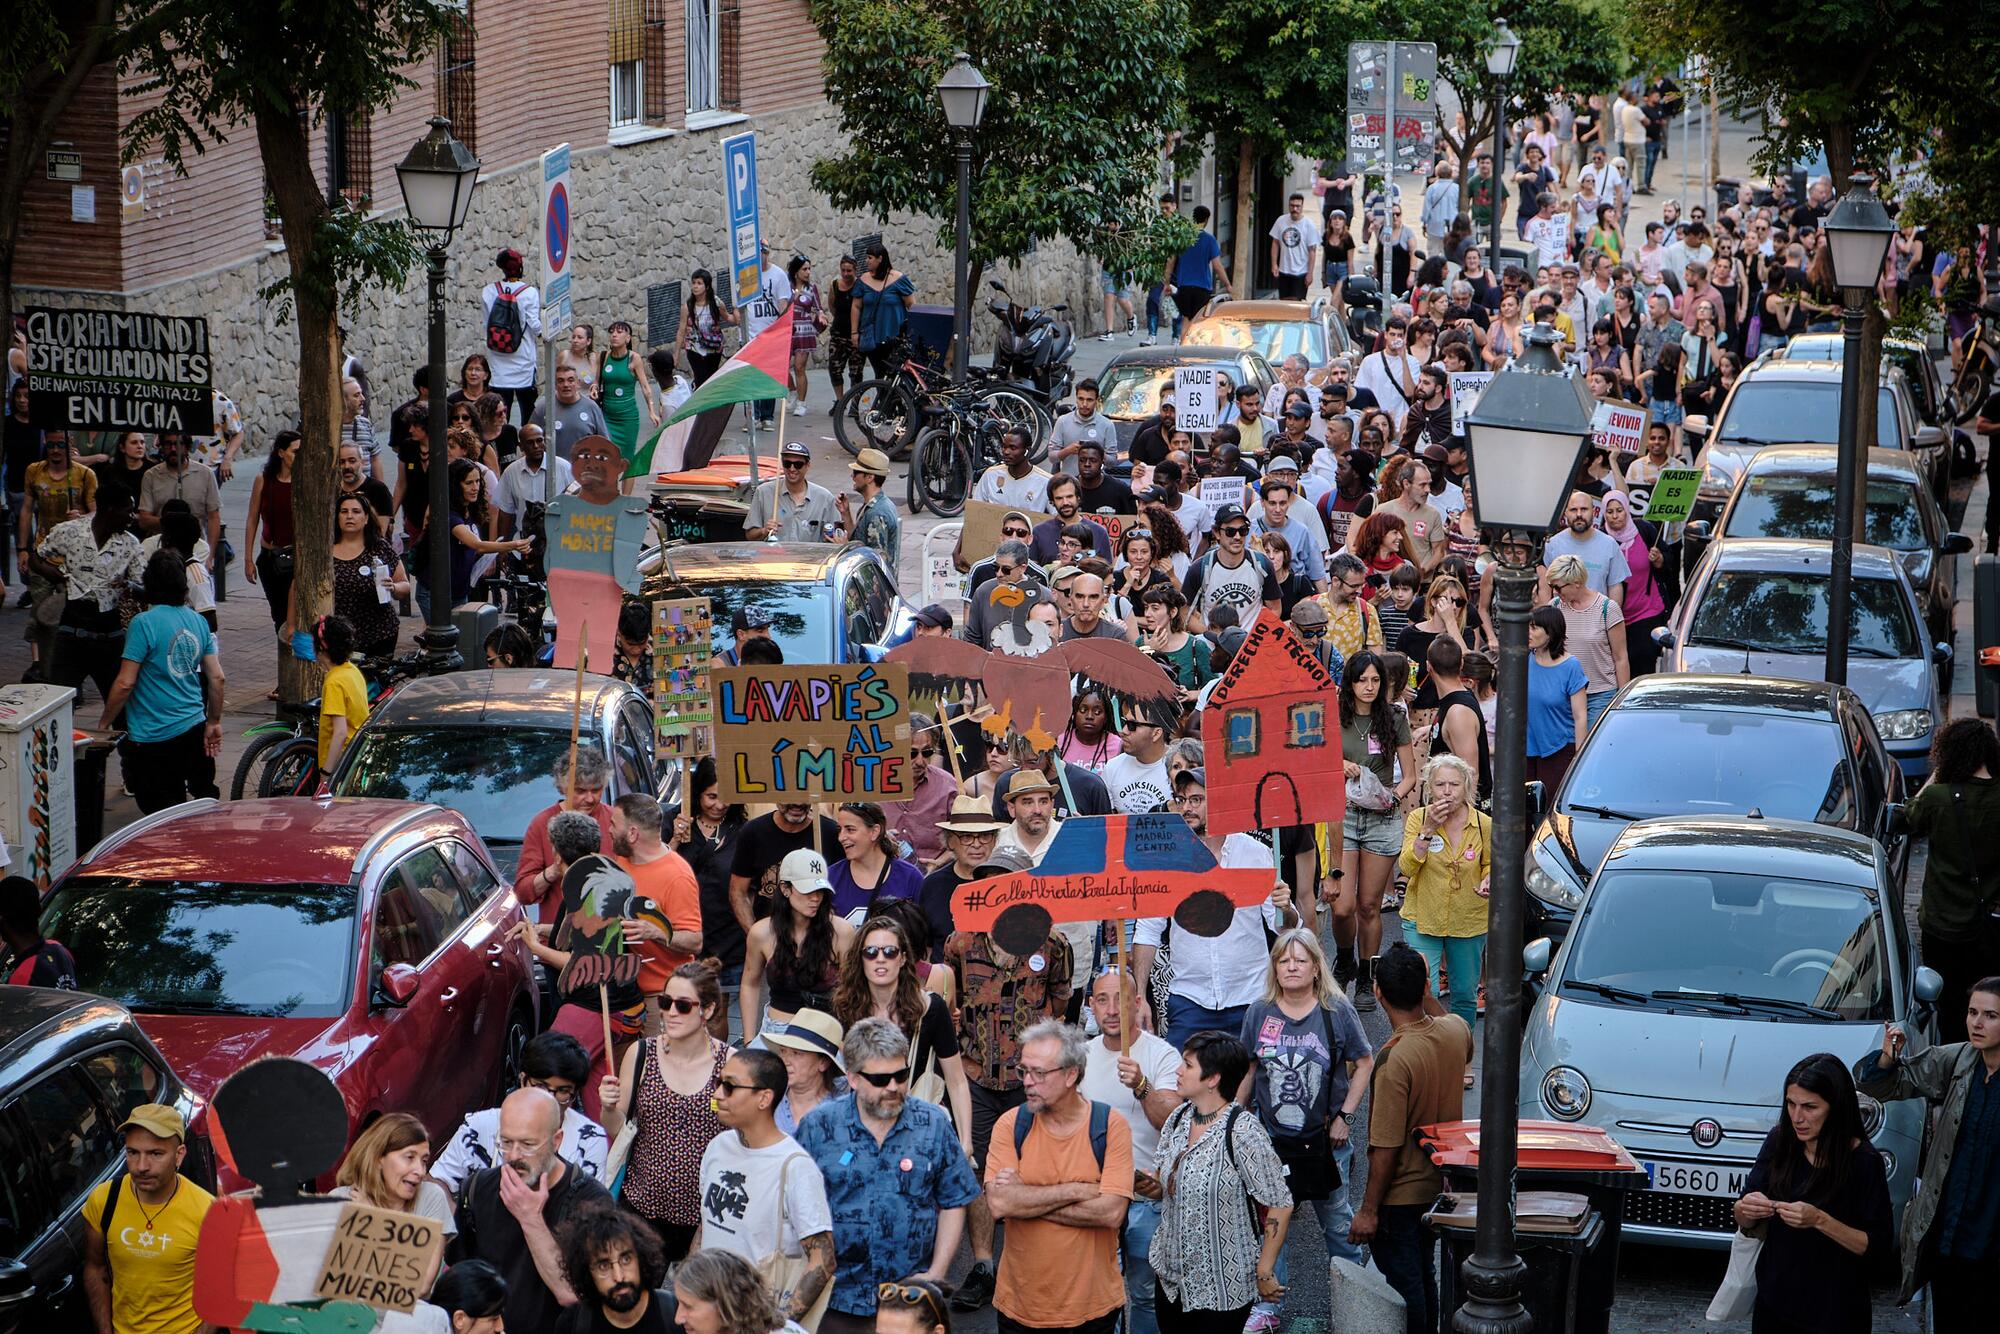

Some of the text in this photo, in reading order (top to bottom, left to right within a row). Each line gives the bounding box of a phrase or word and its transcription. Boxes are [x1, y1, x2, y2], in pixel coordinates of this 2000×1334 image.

[734, 153, 748, 210] P
[28, 344, 208, 384] ESPECULACIONES
[124, 384, 132, 396] Y
[1189, 392, 1202, 406] ES
[68, 396, 183, 430] EN LUCHA
[1609, 432, 1640, 451] DELITO
[1662, 470, 1698, 480] NADIE
[1666, 488, 1682, 498] ES
[570, 513, 615, 532] MAME
[1222, 582, 1256, 598] PUEBLO
[1272, 626, 1284, 641] A
[1284, 637, 1332, 692] TECHO!
[847, 724, 894, 754] AL
[1120, 782, 1166, 804] QUIKSILVER
[1135, 842, 1177, 852] CENTRO
[964, 876, 1172, 912] #CallesAbiertasParaLaInfancia
[1700, 1128, 1715, 1140] FIAT
[1659, 1166, 1718, 1192] 5660
[340, 1210, 431, 1248] 12.300
[330, 1242, 421, 1281] NIÑES
[320, 1272, 416, 1308] MUERTOS
